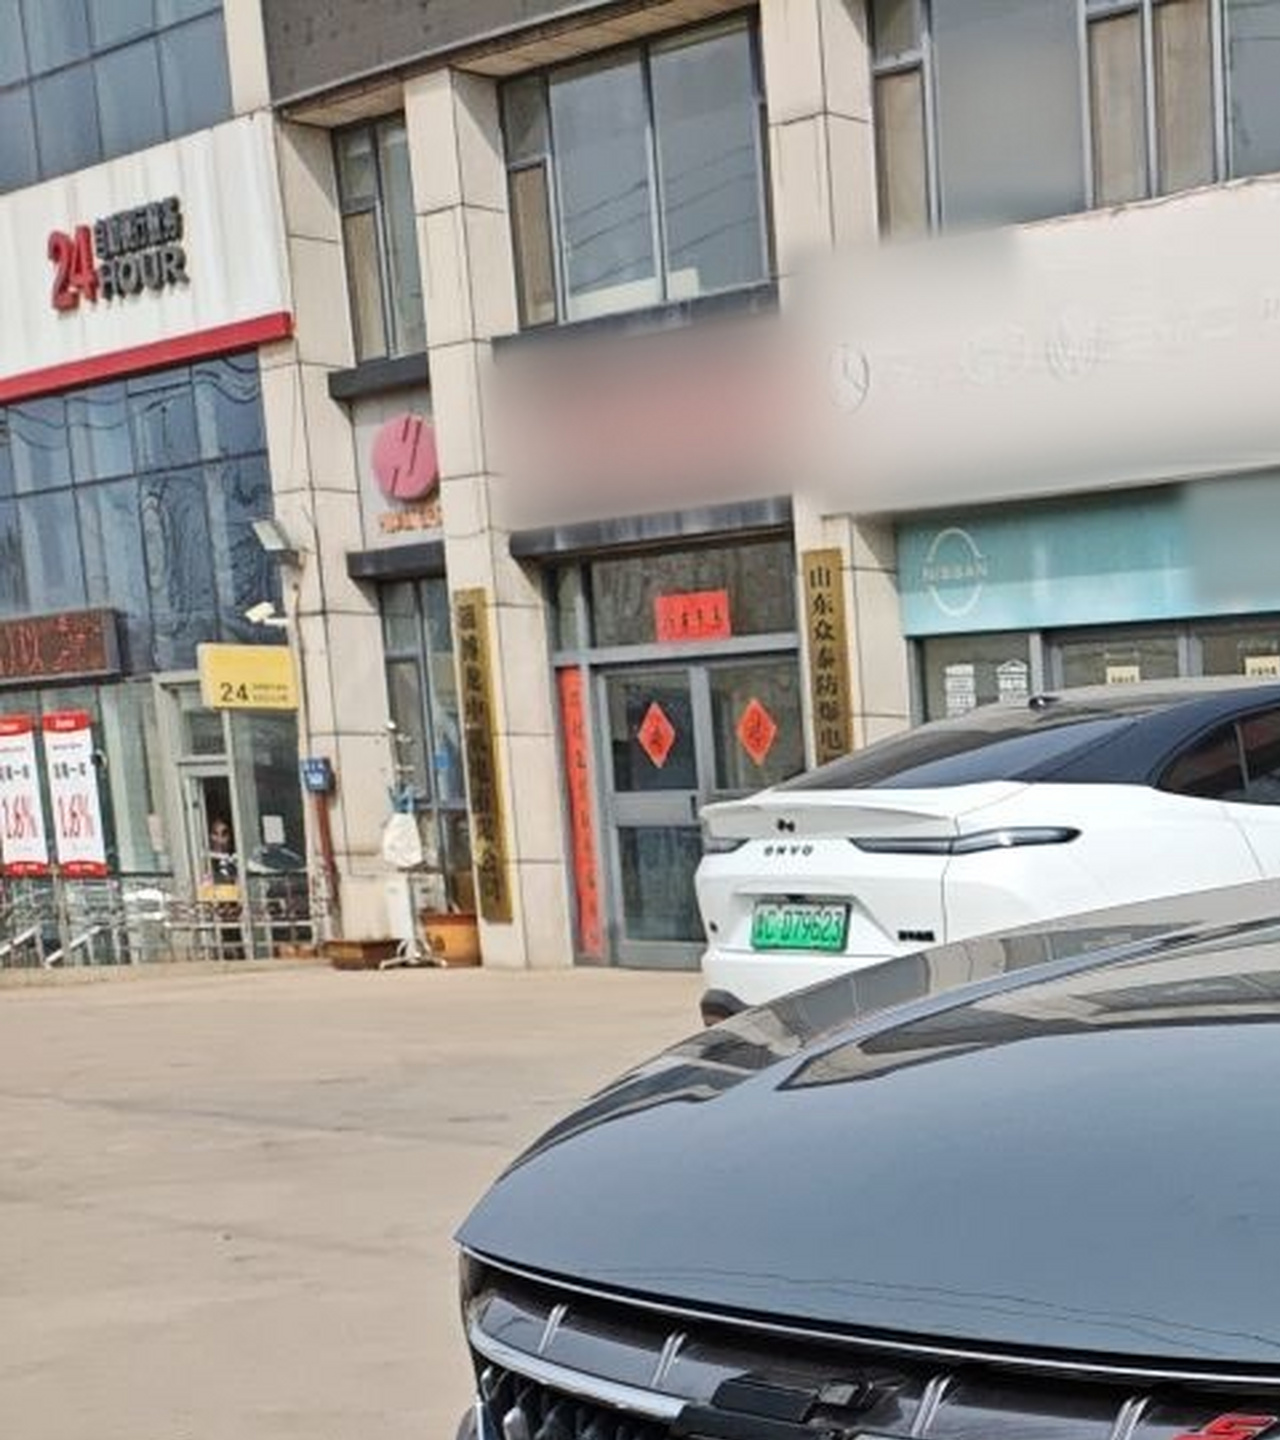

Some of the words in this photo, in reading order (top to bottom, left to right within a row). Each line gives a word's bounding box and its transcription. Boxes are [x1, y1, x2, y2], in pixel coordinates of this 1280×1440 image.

[48, 225, 98, 312] 24
[100, 246, 190, 301] HOUR
[922, 559, 988, 582] NISSAN
[219, 681, 249, 702] 24
[810, 566, 843, 764] 山东众泰防爆电
